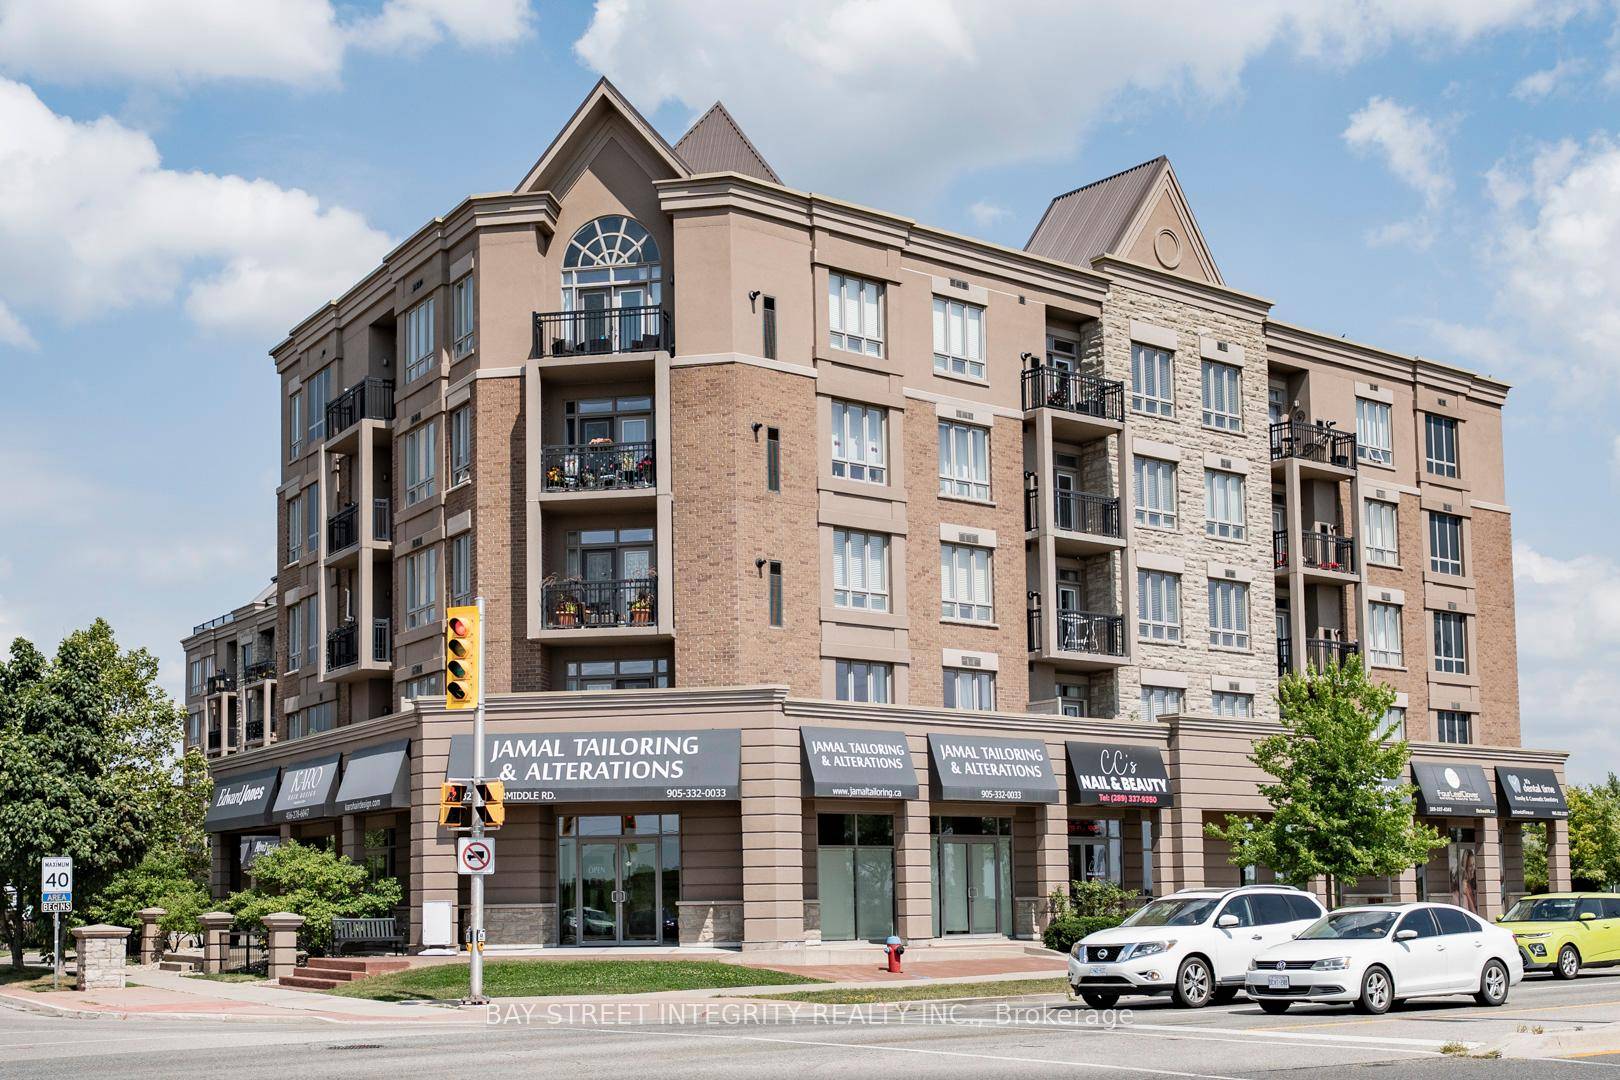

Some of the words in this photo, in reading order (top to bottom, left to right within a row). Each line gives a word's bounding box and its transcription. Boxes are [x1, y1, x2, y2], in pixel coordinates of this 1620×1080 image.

[490, 739, 564, 762] JAMAL
[573, 736, 699, 757] TAILORING
[811, 740, 847, 755] JAMAL
[848, 743, 905, 756] TAILORING
[940, 744, 979, 760] JAMAL
[980, 746, 1043, 762] TAILORING
[821, 756, 831, 767] &
[833, 755, 903, 769] ALTERATIONS
[1100, 749, 1138, 776] CC's
[499, 763, 517, 781] &
[525, 760, 684, 781] ALTERATIONS
[951, 762, 962, 774] &
[964, 762, 1042, 778] ALTERATIONS
[291, 767, 322, 792] KARO
[1080, 774, 1111, 790] NAIL
[1111, 778, 1121, 791] &
[1121, 776, 1167, 792] BEAUTY
[666, 788, 727, 798] 905-332-0033
[832, 787, 902, 798] www.jamaltailoring.ca
[981, 790, 1022, 800] 905-332-0033
[1523, 783, 1541, 793] dental
[541, 791, 556, 800] RD.
[1098, 793, 1110, 802] Tel:
[1110, 794, 1127, 803] (289)
[345, 799, 381, 811] karohairdesign.com
[45, 872, 69, 887] 40
[43, 902, 71, 911] BEGINS
